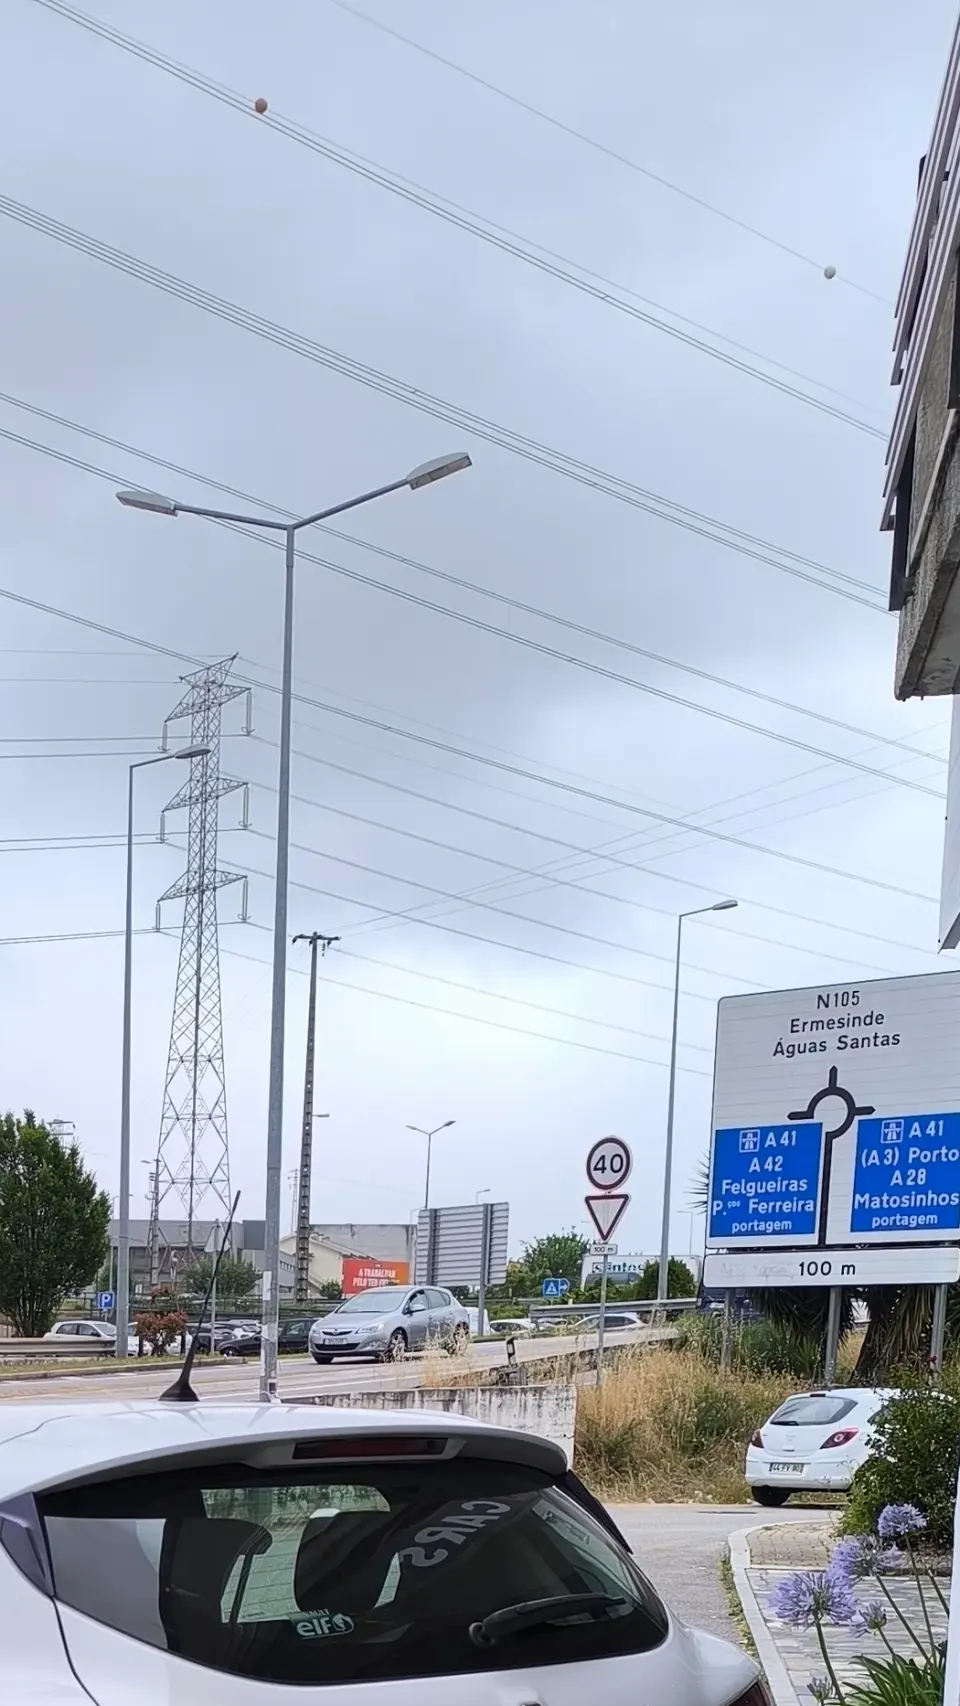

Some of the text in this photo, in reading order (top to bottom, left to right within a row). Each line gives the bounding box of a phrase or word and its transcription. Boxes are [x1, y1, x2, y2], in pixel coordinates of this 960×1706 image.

[790, 1010, 885, 1034] Ermesinde
[773, 1032, 901, 1058] Águas Santas
[593, 1153, 624, 1174] 40
[908, 1145, 960, 1163] Porto
[722, 1176, 808, 1197] Felgueiras
[748, 1196, 814, 1214] Ferreira
[854, 1190, 959, 1210] Matosinhos
[731, 1219, 792, 1234] portagem
[872, 1213, 938, 1229] portagem
[799, 1261, 832, 1276] 100
[841, 1263, 856, 1276] m
